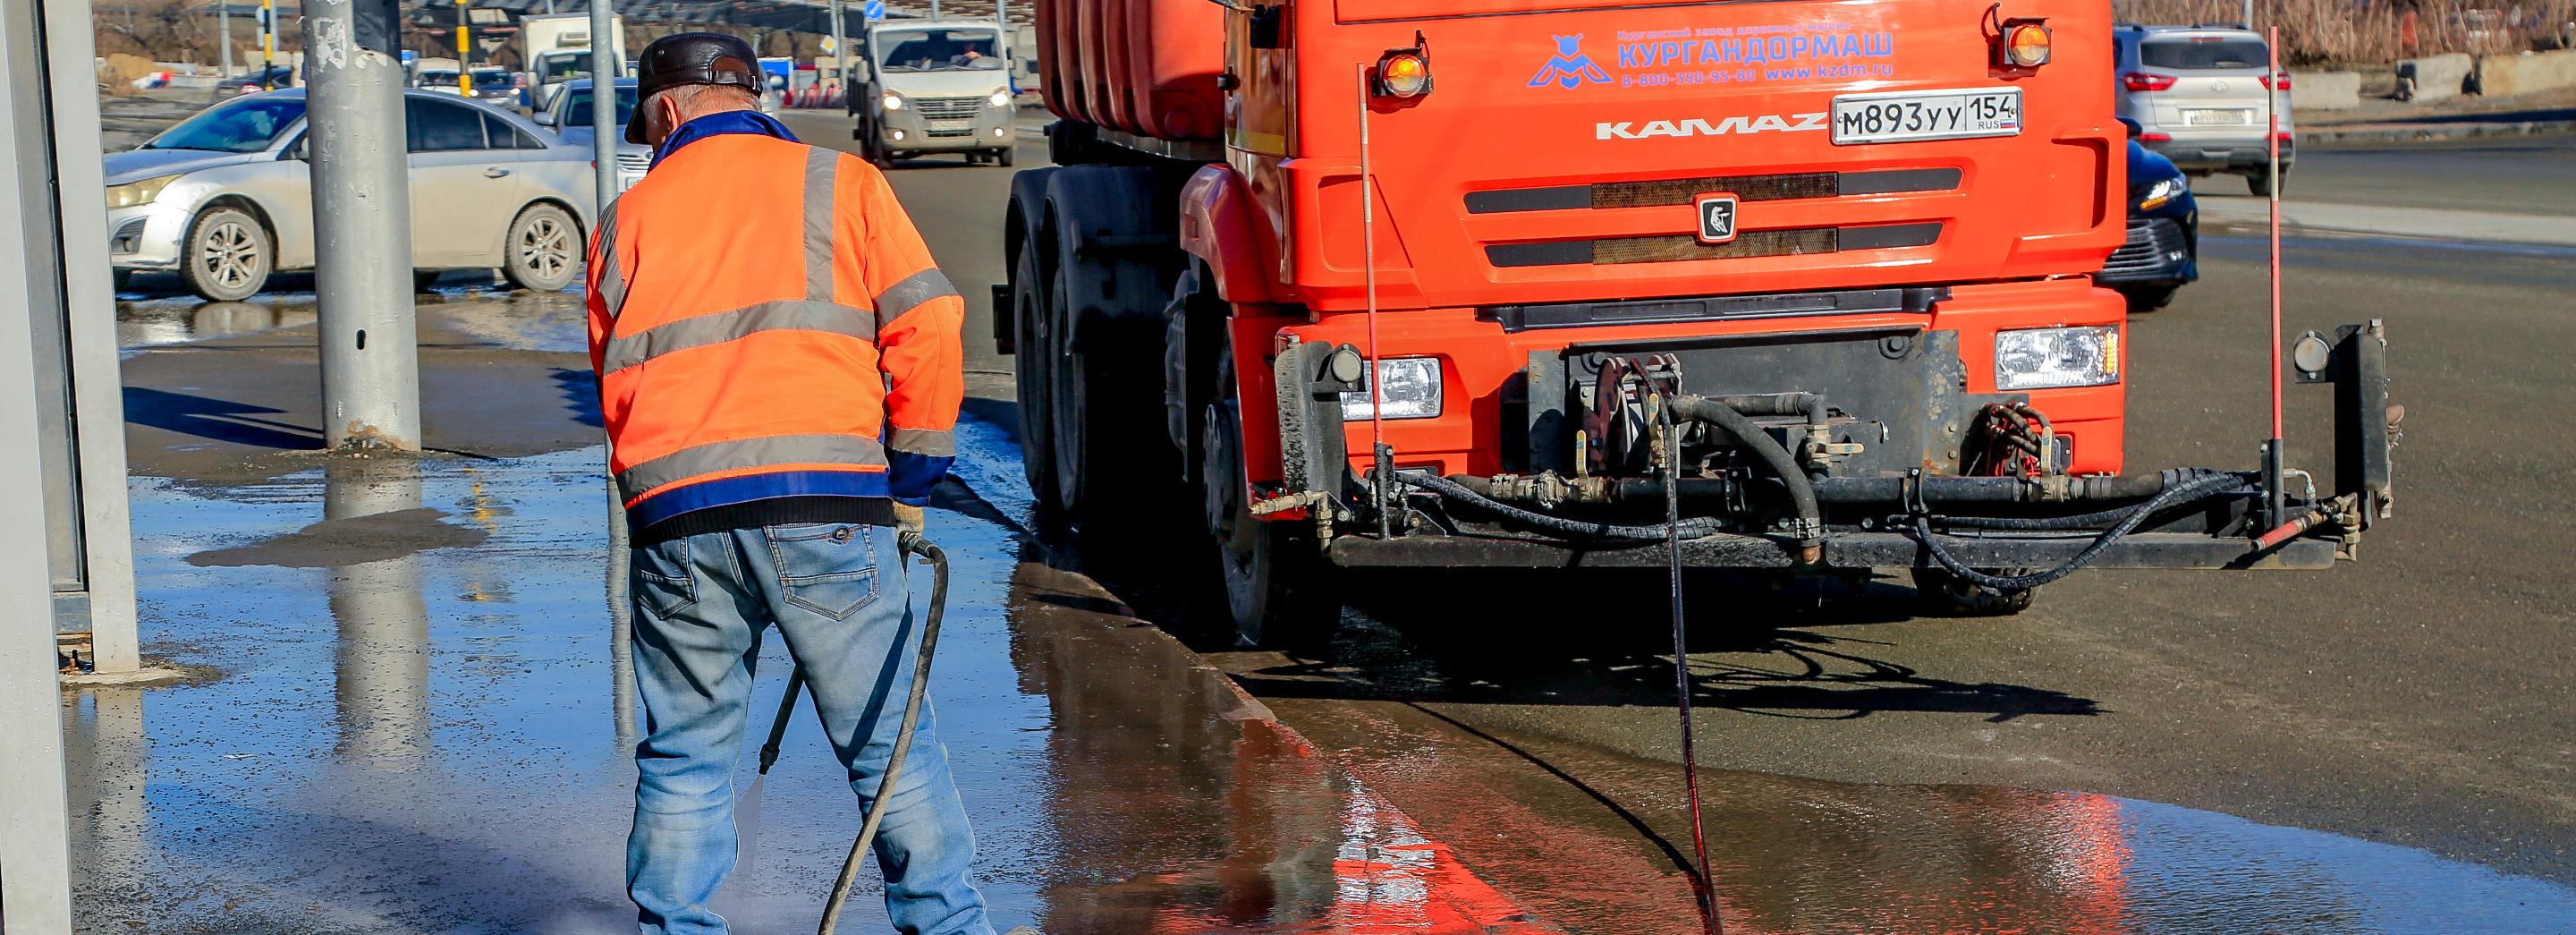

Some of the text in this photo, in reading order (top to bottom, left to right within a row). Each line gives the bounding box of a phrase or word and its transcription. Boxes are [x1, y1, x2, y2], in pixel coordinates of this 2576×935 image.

[1619, 32, 1894, 68] КУРГАНДОРМАШ
[1622, 69, 1756, 87] 8-800-350-95-80
[1970, 96, 2012, 121] 154
[1597, 111, 1828, 140] KAMAZ
[1978, 120, 2000, 130] RUS
